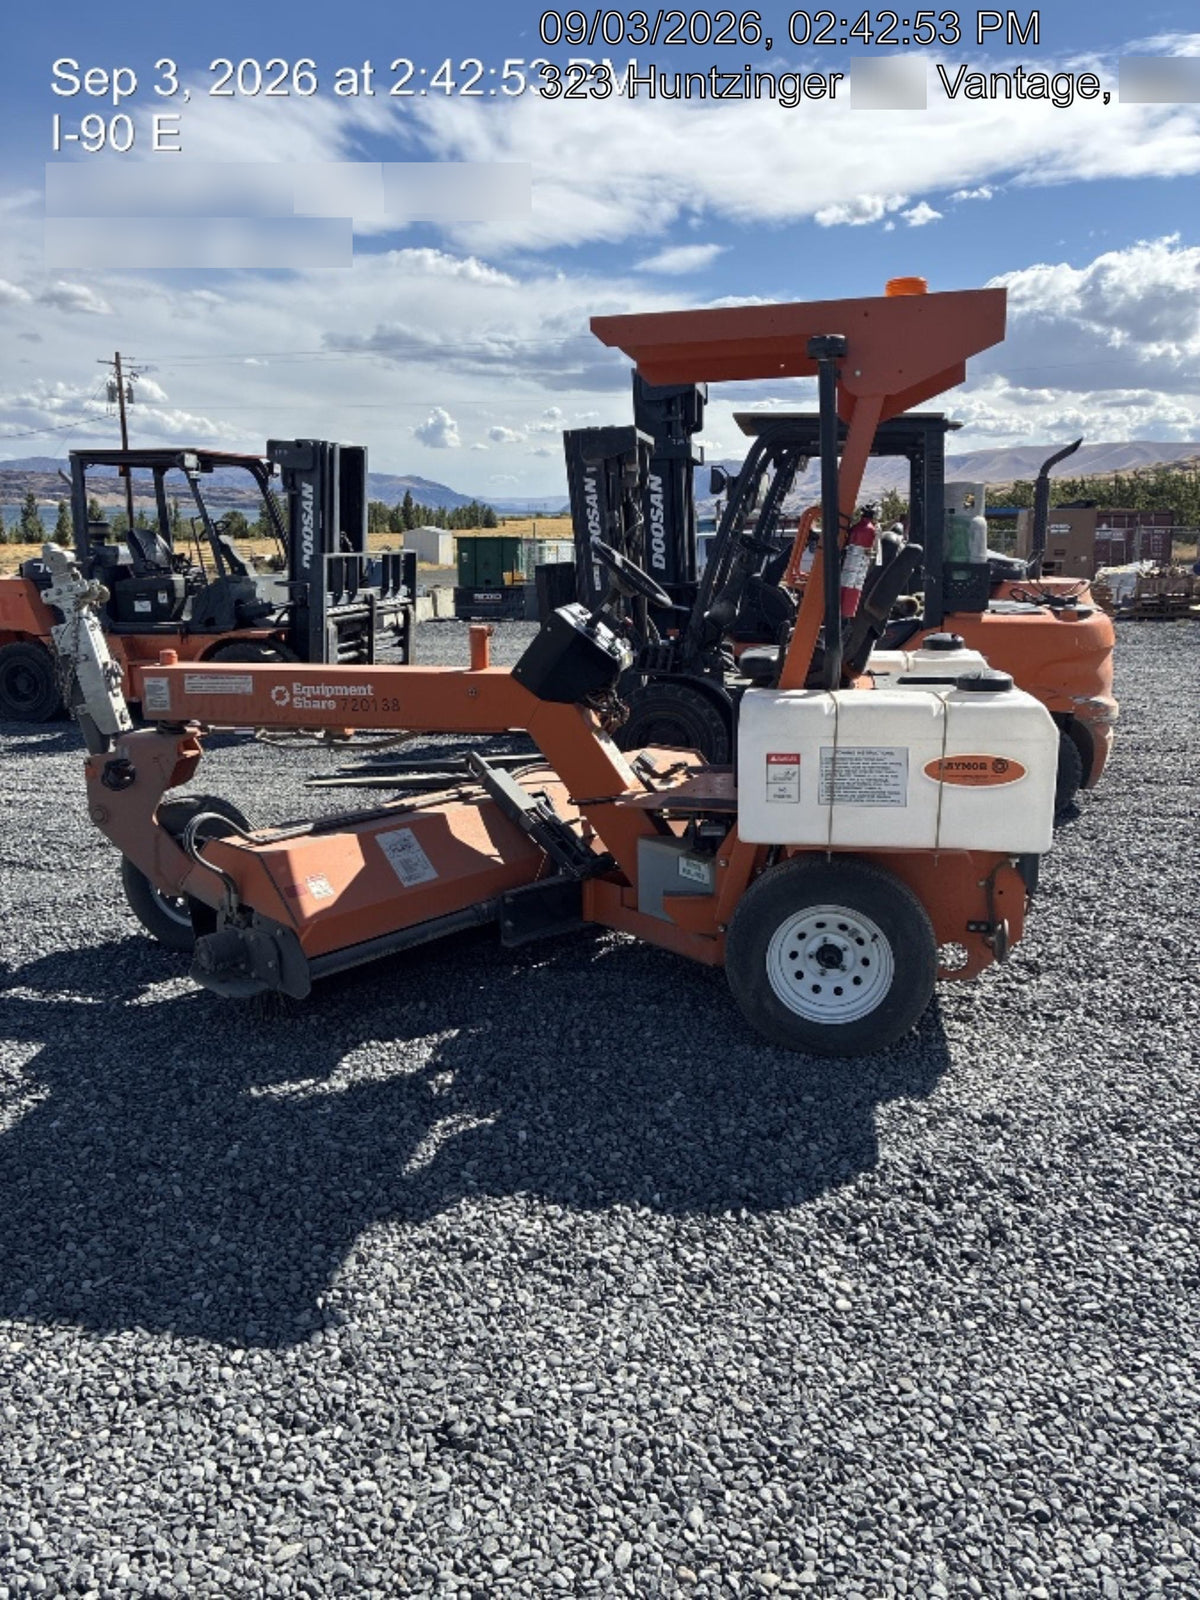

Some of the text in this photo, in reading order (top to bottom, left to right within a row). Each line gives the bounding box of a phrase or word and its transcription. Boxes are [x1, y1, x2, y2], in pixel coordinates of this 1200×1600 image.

[649, 473, 666, 570] DOOSAN
[292, 682, 375, 698] Equipment
[292, 697, 337, 710] Share
[341, 697, 401, 713] 720138
